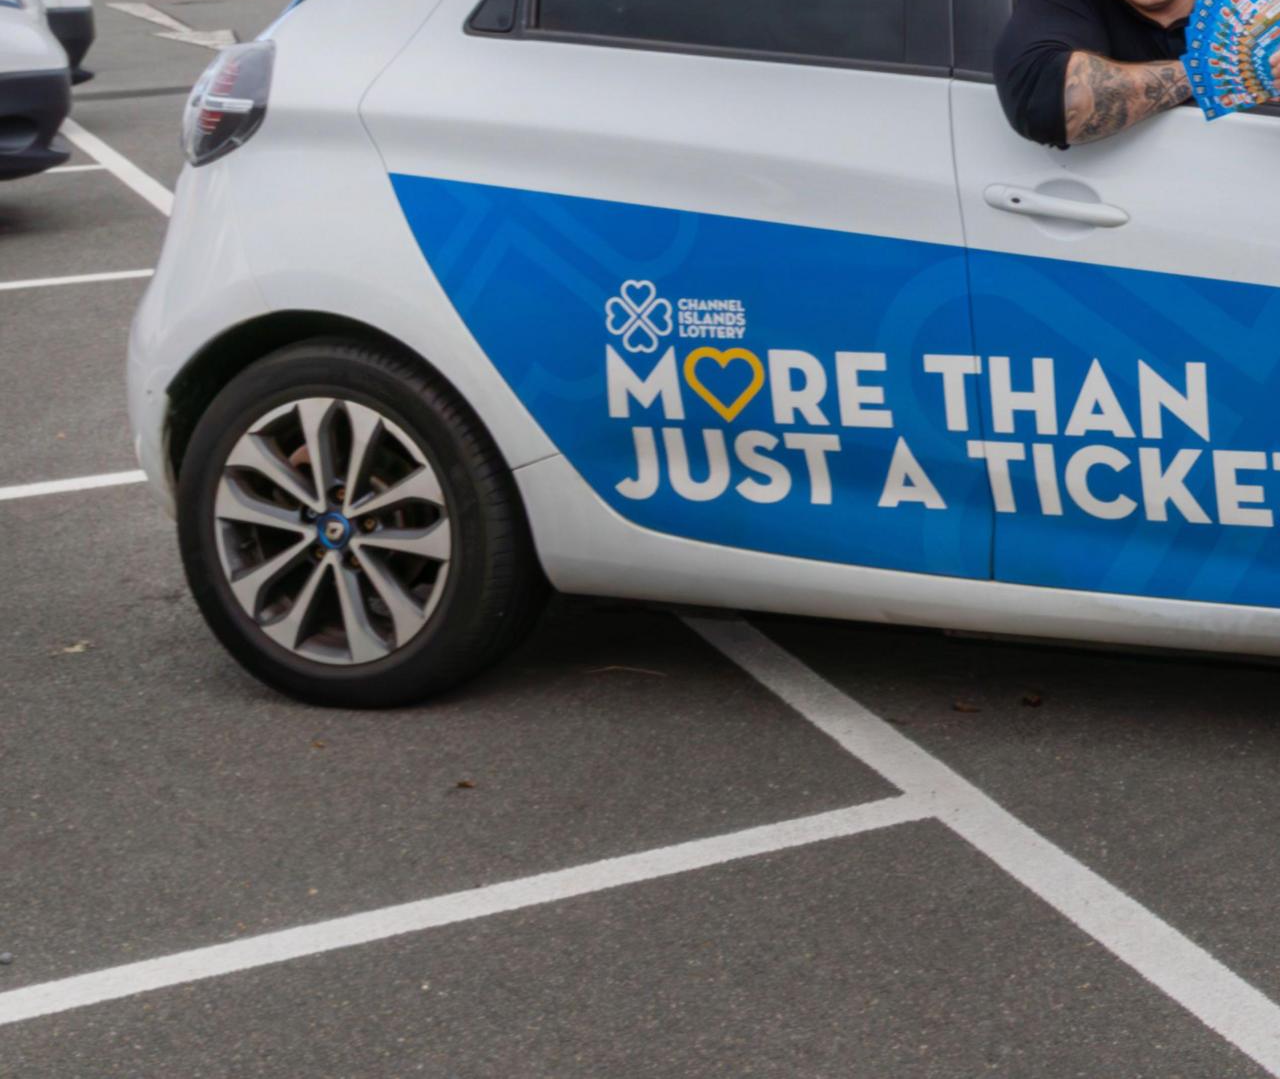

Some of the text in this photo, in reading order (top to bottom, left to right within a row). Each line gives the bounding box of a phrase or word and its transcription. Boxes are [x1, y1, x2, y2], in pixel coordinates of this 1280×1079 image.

[678, 298, 745, 312] CHANNEL
[678, 311, 746, 326] ISLANDS
[679, 325, 746, 339] LOTTERY
[923, 353, 1210, 442] THAN
[615, 426, 841, 505] JUST
[878, 435, 947, 510] A
